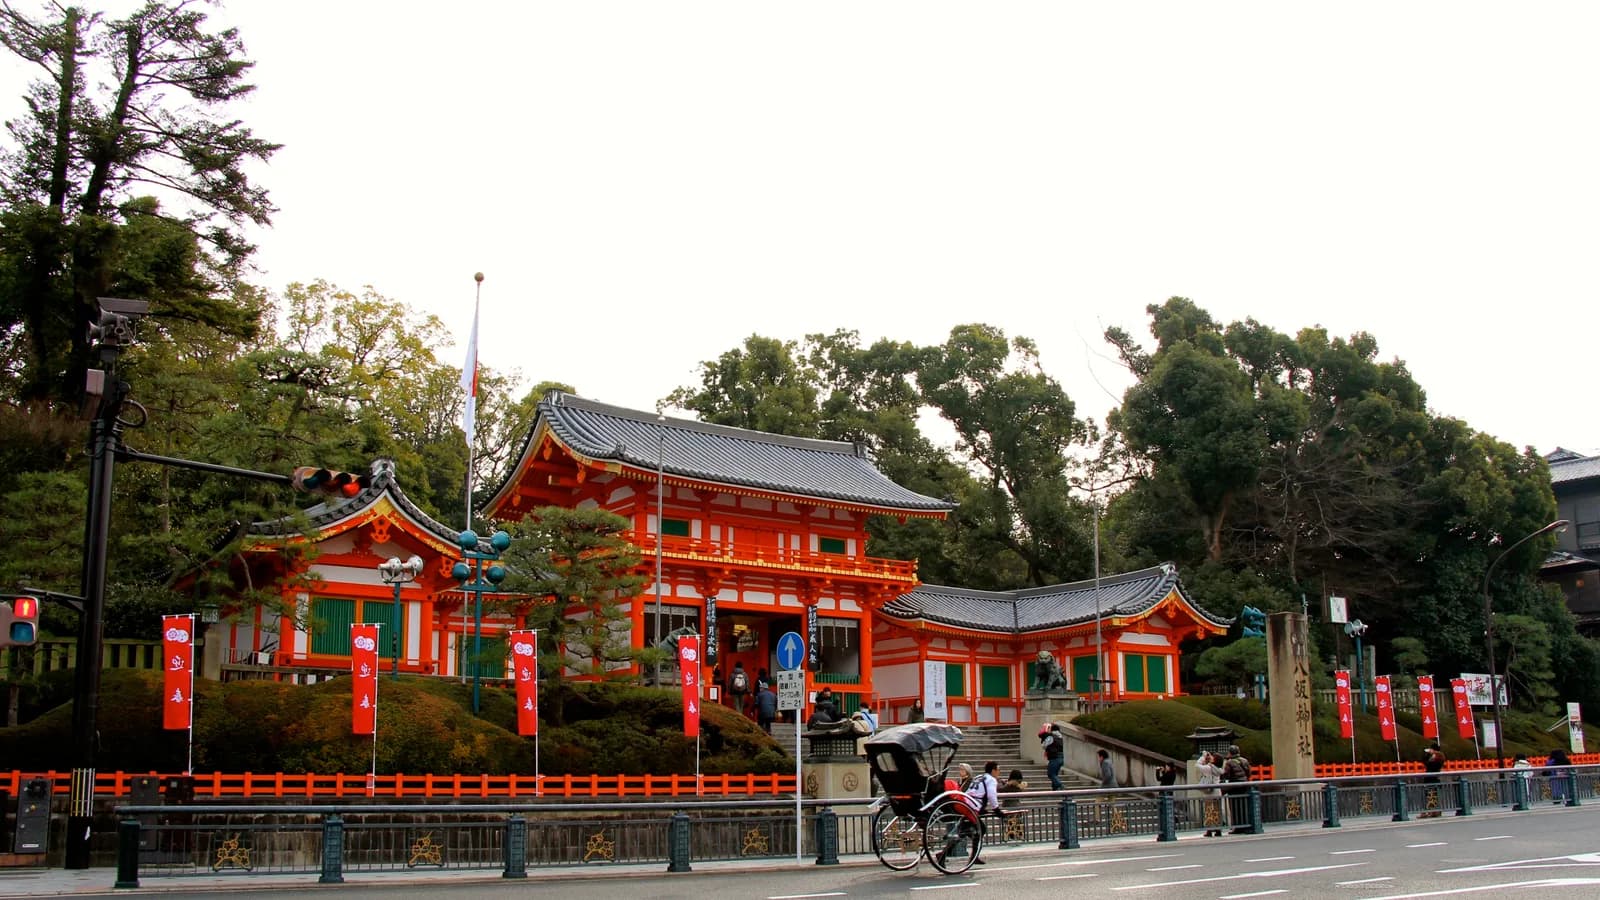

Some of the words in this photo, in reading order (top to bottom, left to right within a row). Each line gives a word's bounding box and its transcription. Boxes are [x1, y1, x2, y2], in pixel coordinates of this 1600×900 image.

[169, 655, 185, 703] 迎春
[359, 661, 371, 709] 迎春
[520, 667, 534, 711] 迎春
[1294, 661, 1312, 759] 八坂神社
